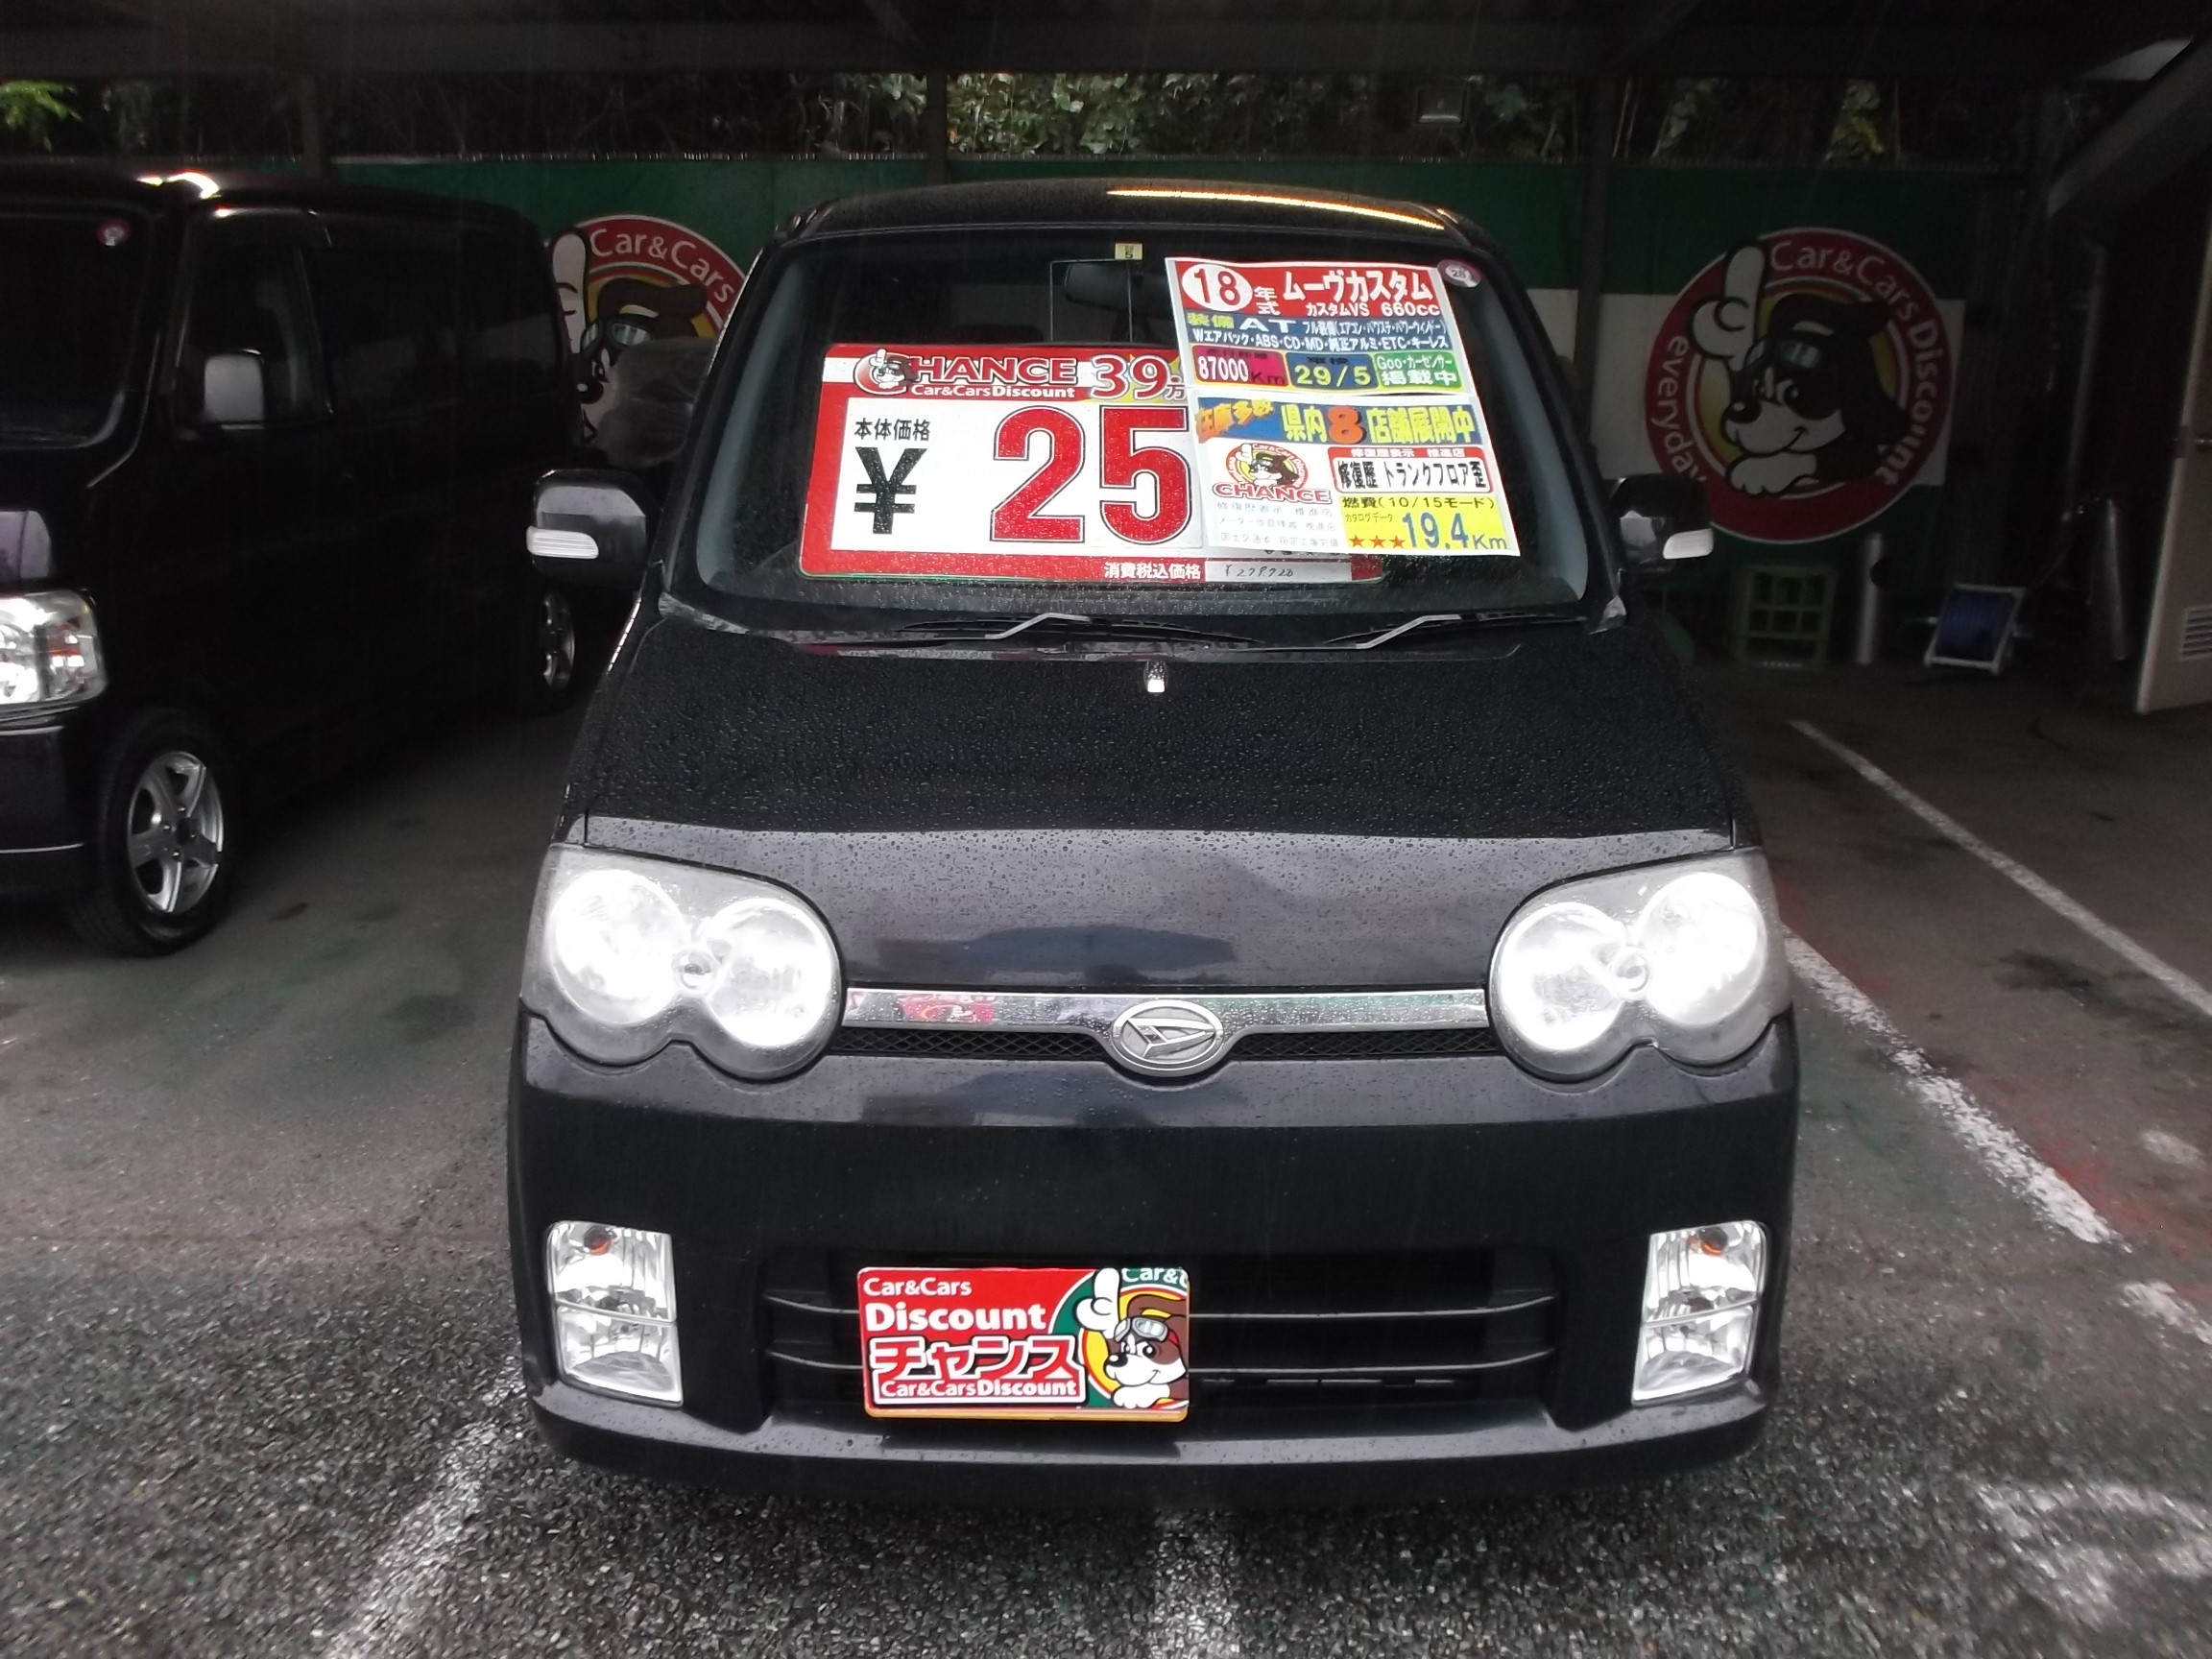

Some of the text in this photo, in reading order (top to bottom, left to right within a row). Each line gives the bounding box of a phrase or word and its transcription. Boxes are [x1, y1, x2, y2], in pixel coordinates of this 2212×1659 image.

[589, 228, 735, 303] Car&Cars
[1192, 268, 1243, 309] 18
[1283, 270, 1434, 303] ムーヴカスタム
[1770, 241, 1918, 321] Car&Cars
[1381, 301, 1441, 317] 660cc
[1238, 317, 1297, 334] AT
[1197, 355, 1249, 383] 87000
[854, 417, 931, 443] 本体価格
[854, 404, 1192, 545] ¥ 25
[1213, 483, 1333, 504] CHANCE
[1402, 512, 1469, 550] 19.4
[1104, 563, 1201, 580] 消費税込価格
[863, 1277, 973, 1296] Car&Cars
[865, 1301, 1047, 1334] Discount
[871, 1337, 1076, 1382] チャンス
